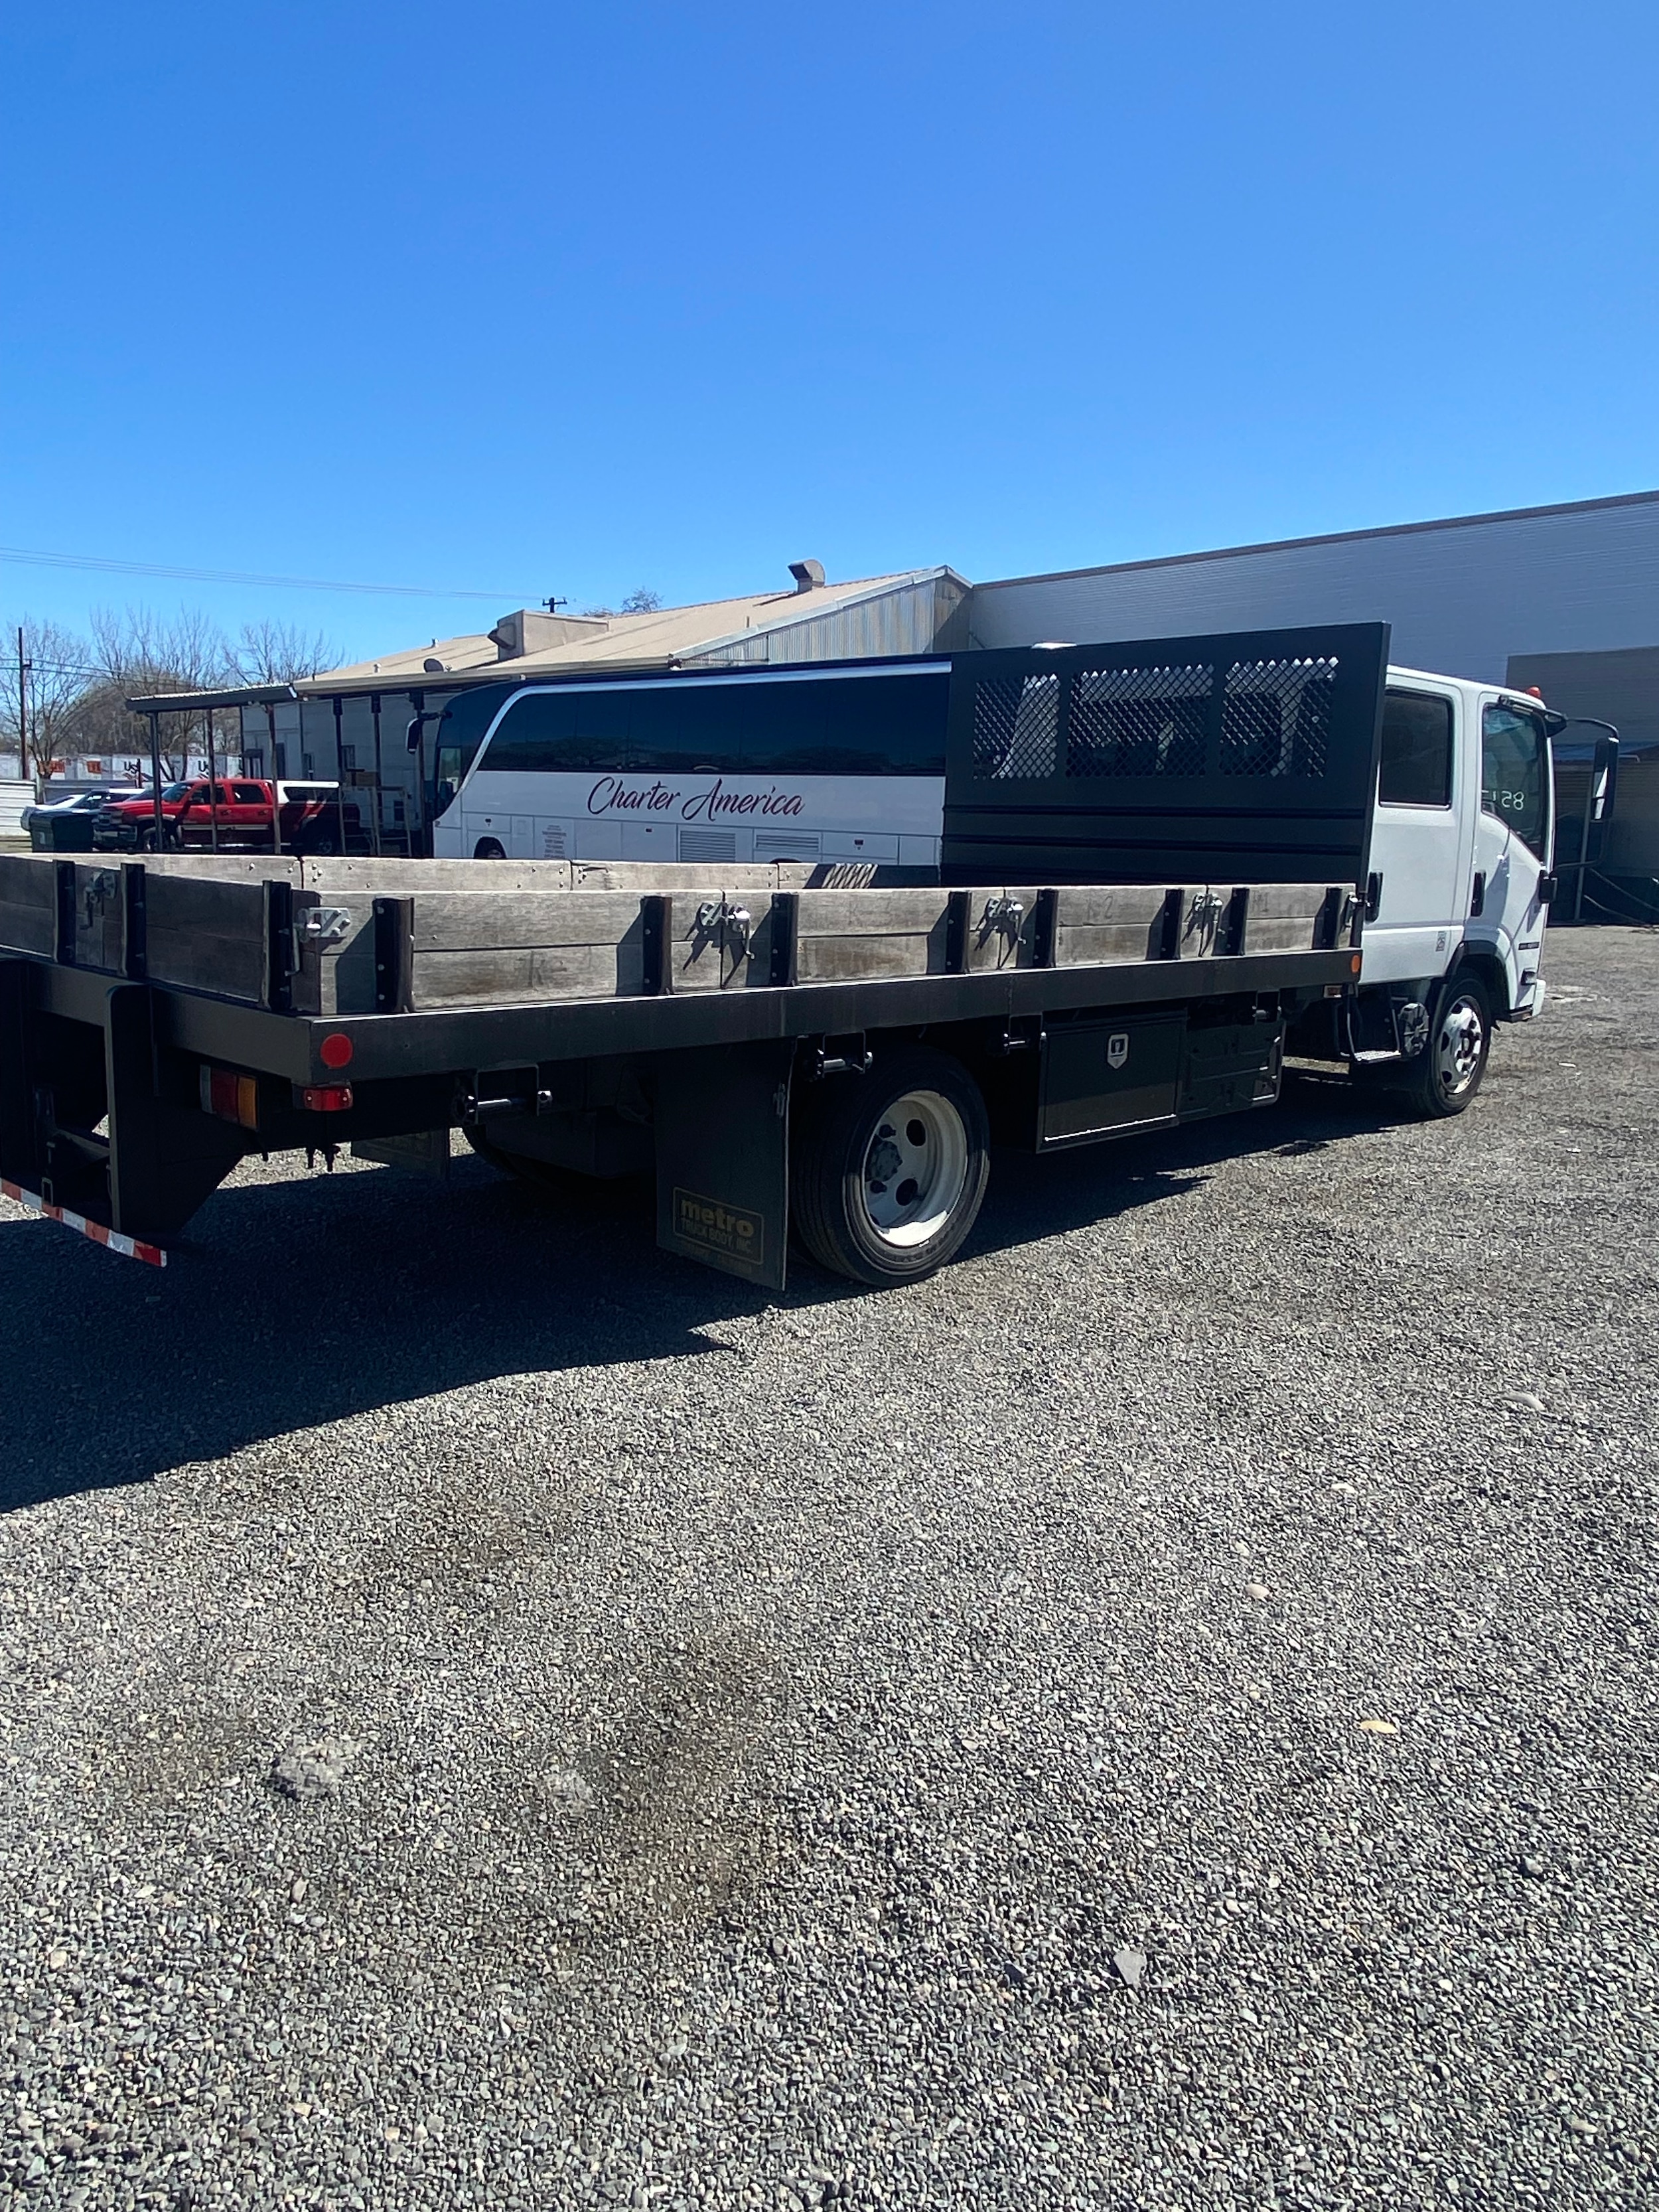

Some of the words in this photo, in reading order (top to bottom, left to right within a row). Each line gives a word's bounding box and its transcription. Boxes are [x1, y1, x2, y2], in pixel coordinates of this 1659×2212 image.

[588, 776, 681, 814] Charter
[682, 778, 805, 822] America
[681, 1199, 755, 1238] metro
